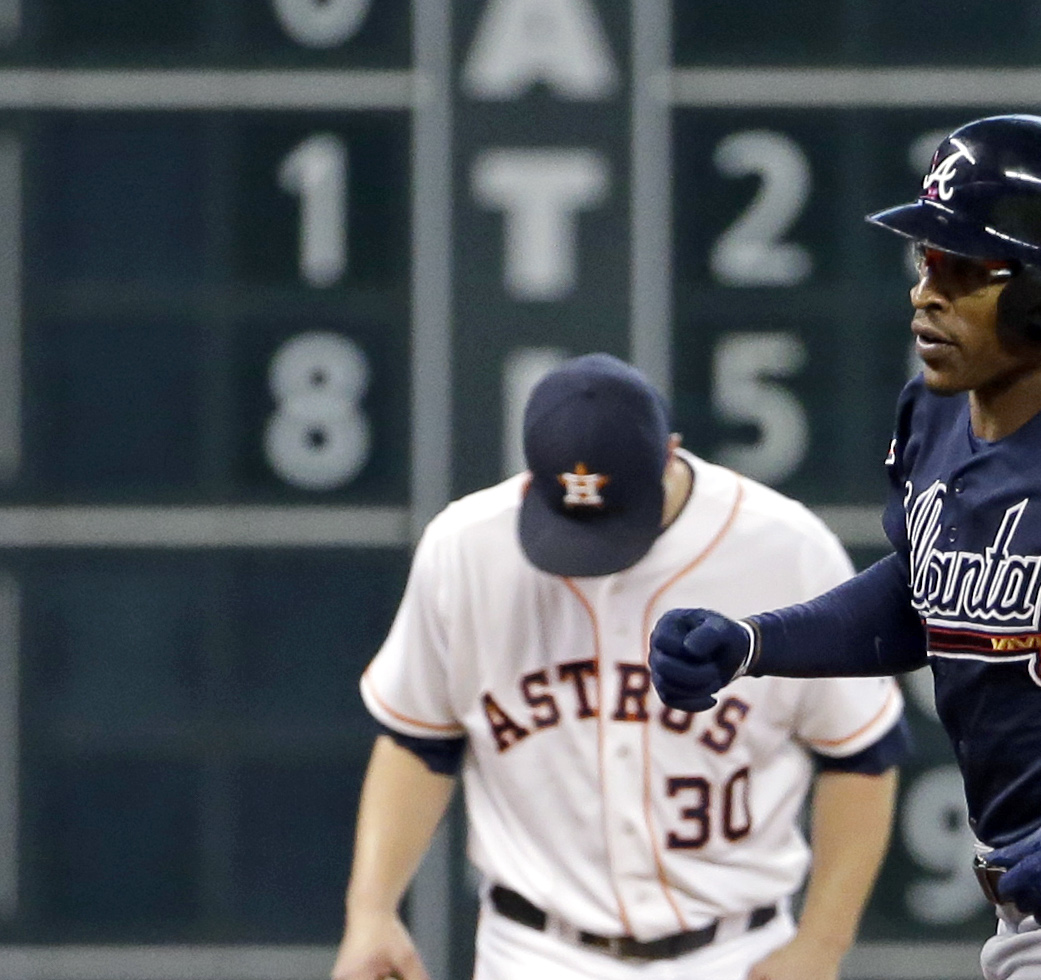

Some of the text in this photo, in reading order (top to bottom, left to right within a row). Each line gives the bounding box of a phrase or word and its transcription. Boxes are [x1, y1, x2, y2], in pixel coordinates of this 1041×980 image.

[277, 132, 348, 288] 1
[711, 131, 812, 287] 2
[265, 332, 371, 491] 8
[712, 331, 808, 487] 5
[666, 766, 753, 850] 30
